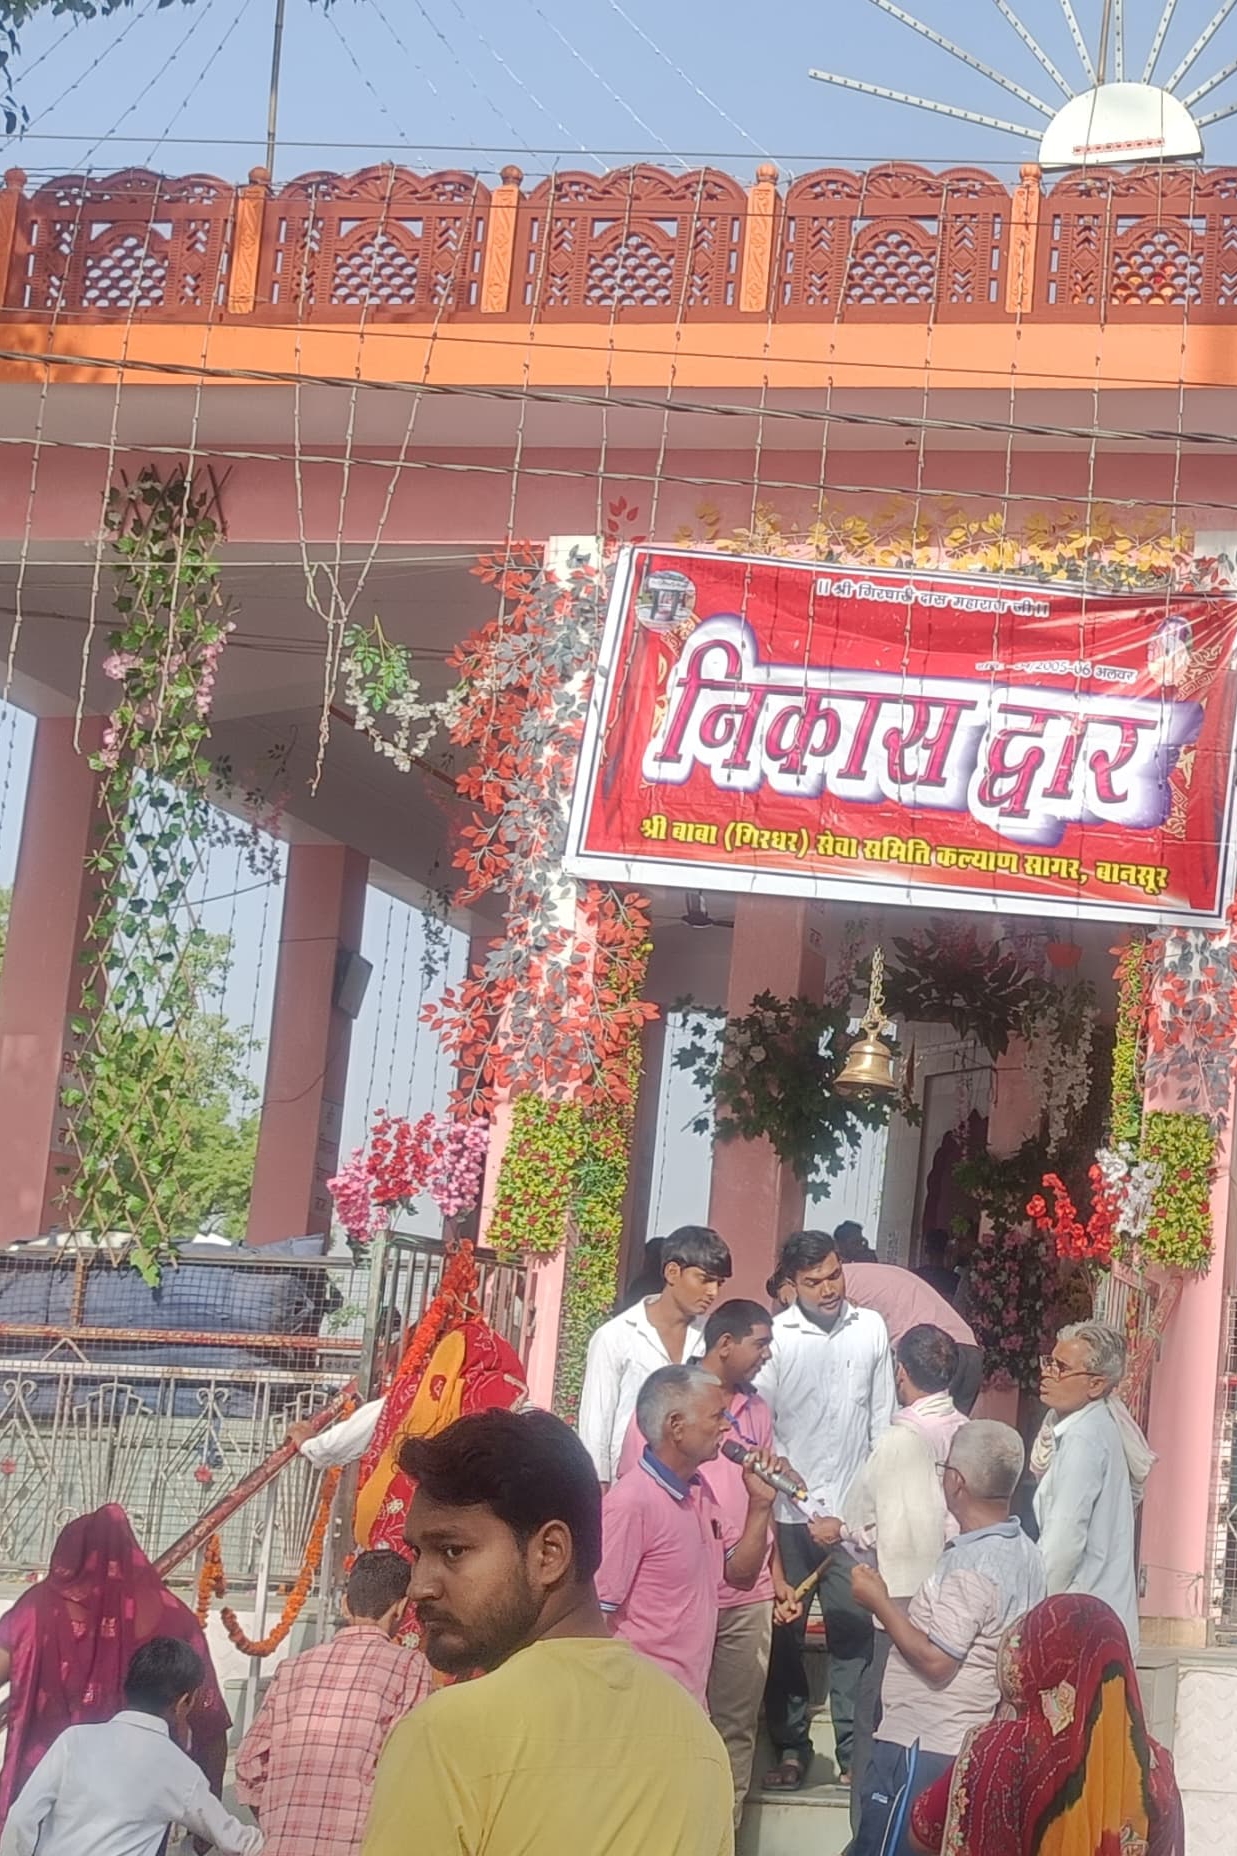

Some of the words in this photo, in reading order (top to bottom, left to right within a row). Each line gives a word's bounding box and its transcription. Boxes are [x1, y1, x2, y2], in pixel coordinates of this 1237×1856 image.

[833, 581, 853, 596] श्री
[920, 591, 948, 607] दास
[953, 595, 1008, 613] महाराज
[1095, 666, 1137, 682] अलवर
[653, 637, 978, 788] निकास
[978, 703, 1158, 819] द्वार
[639, 815, 668, 840] श्री
[671, 821, 718, 845] बाबा
[723, 822, 810, 859] (गिरधर)
[816, 830, 859, 859] सेवा
[862, 836, 932, 865] समिति
[936, 845, 1020, 874] कल्याण
[1023, 855, 1088, 884] सागर,
[1095, 860, 1169, 895] बानसूर
